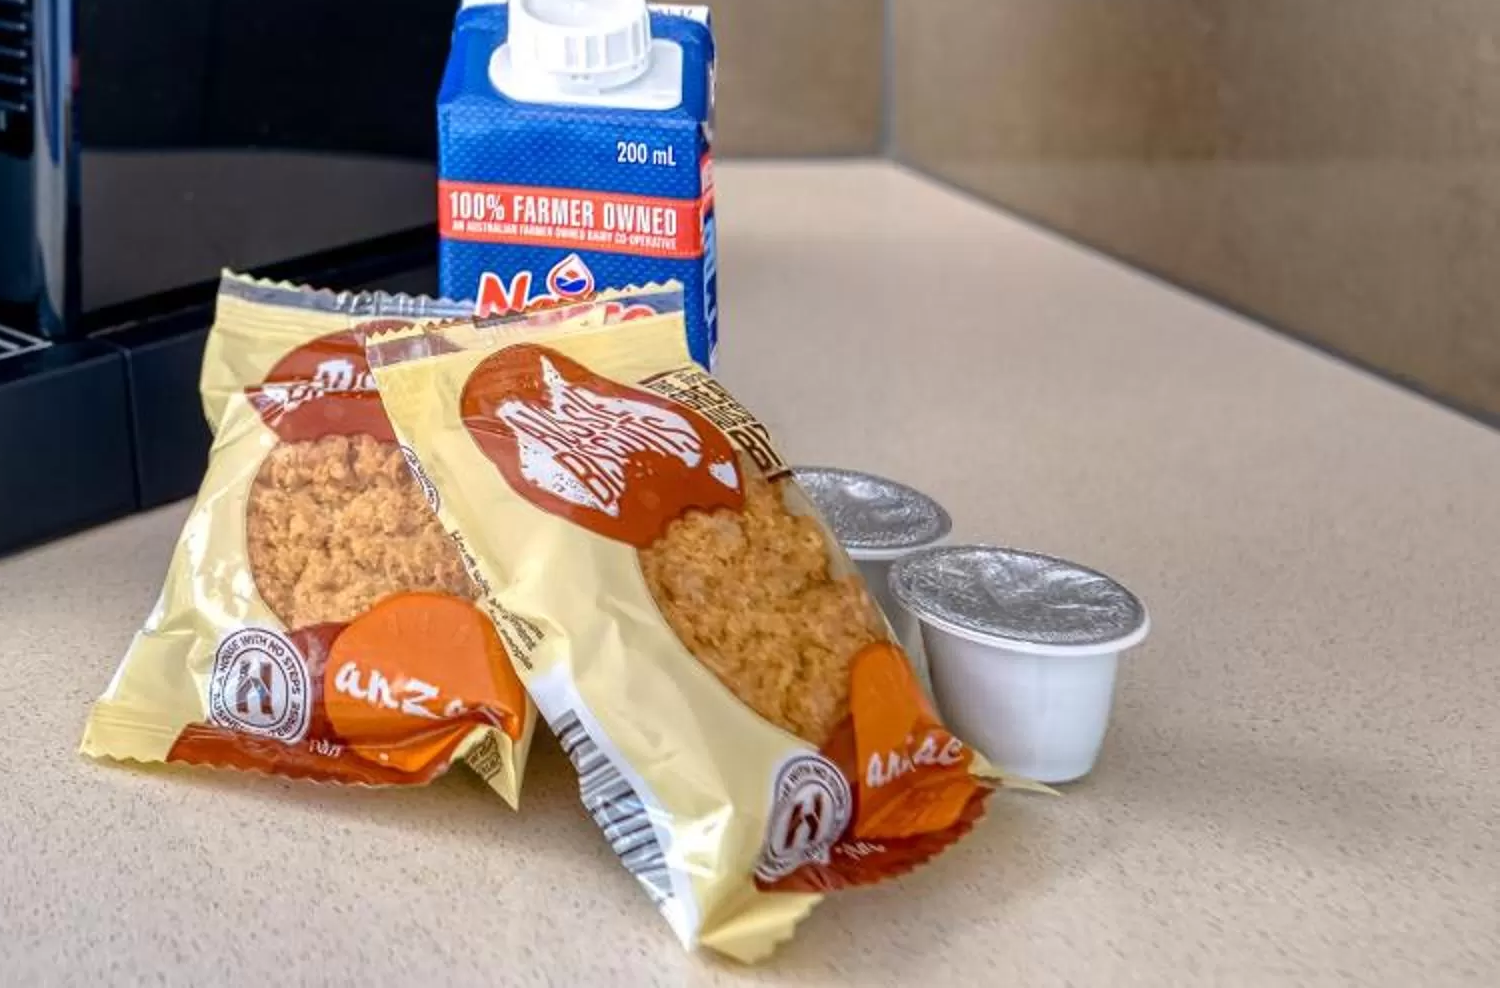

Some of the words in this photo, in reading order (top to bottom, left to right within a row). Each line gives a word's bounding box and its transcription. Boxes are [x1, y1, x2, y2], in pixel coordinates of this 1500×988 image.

[616, 141, 648, 165] 200
[652, 143, 677, 167] mL
[449, 190, 505, 222] 100%
[512, 194, 594, 229] FARMER
[602, 201, 678, 237] OWNED
[504, 382, 632, 453] AUSSIE
[552, 414, 704, 506] BISCUITS
[240, 634, 268, 650] WITH
[266, 639, 286, 657] NO
